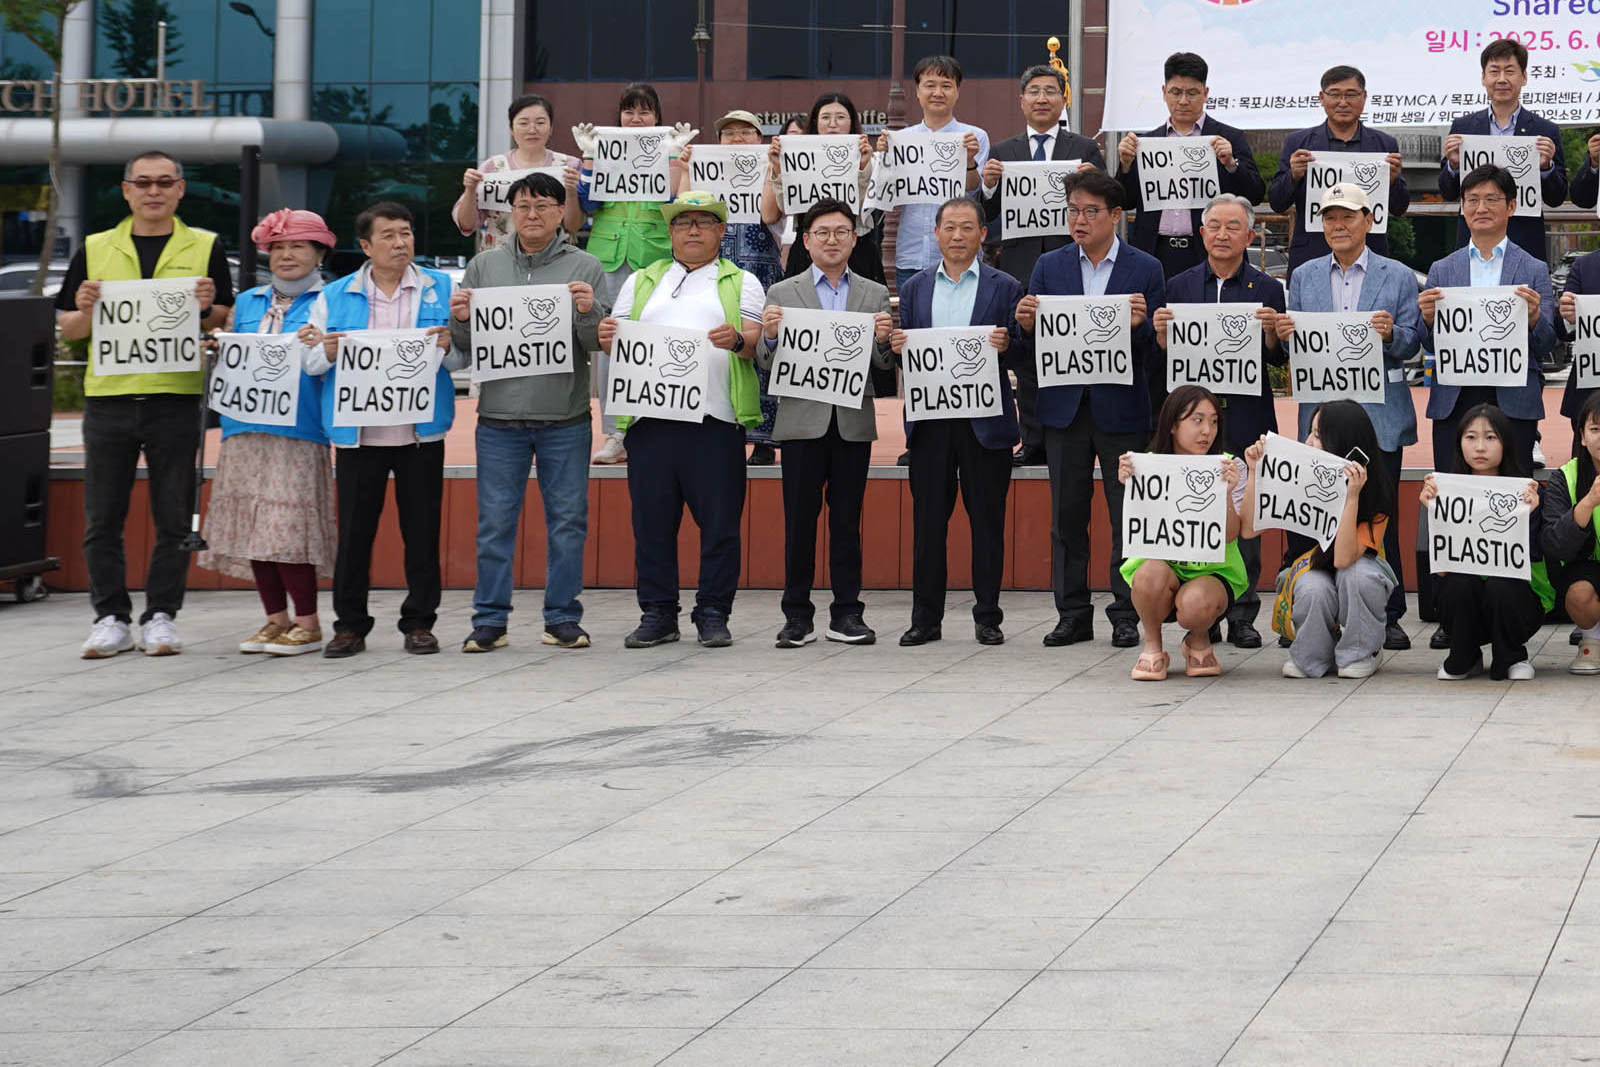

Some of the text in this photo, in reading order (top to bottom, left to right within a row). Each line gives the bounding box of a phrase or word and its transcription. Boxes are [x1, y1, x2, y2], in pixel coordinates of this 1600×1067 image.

[1426, 29, 1469, 53] 일시
[1530, 65, 1557, 79] 주최
[77, 80, 216, 113] HOTEL
[1206, 96, 1229, 110] 협력
[1370, 94, 1438, 108] 목포YMCA
[1372, 111, 1398, 124] 번째
[1400, 110, 1426, 123] 생일
[597, 139, 628, 161] NO!
[783, 151, 815, 173] NO!
[893, 145, 924, 167] NO!
[1141, 150, 1173, 170] NO!
[594, 172, 666, 195] PLASTIC
[692, 161, 725, 182] NO!
[1005, 176, 1037, 197] NO!
[1145, 177, 1217, 202] PLASTIC
[99, 300, 141, 325] NO!
[475, 306, 513, 332] NO!
[1040, 313, 1077, 338] NO!
[1437, 307, 1473, 335] NO!
[782, 326, 820, 353] NO!
[1172, 321, 1208, 347] NO!
[1293, 329, 1330, 355] NO!
[99, 336, 196, 365] PLASTIC
[341, 345, 382, 371] NO!
[476, 340, 567, 371] PLASTIC
[616, 338, 654, 367] NO!
[907, 347, 944, 373] NO!
[1041, 349, 1127, 377] PLASTIC
[1439, 347, 1522, 374] PLASTIC
[775, 361, 864, 397] PLASTIC
[1172, 358, 1257, 385] PLASTIC
[1295, 366, 1381, 392] PLASTIC
[211, 377, 291, 416] PLASTIC
[338, 386, 430, 412] PLASTIC
[612, 377, 701, 411] PLASTIC
[910, 382, 995, 413] PLASTIC
[1260, 456, 1300, 485] NO!
[1131, 475, 1170, 501] NO!
[1259, 491, 1339, 541] PLASTIC
[1434, 495, 1474, 524] NO!
[1128, 517, 1222, 550] PLASTIC
[1433, 534, 1525, 570] PLASTIC
